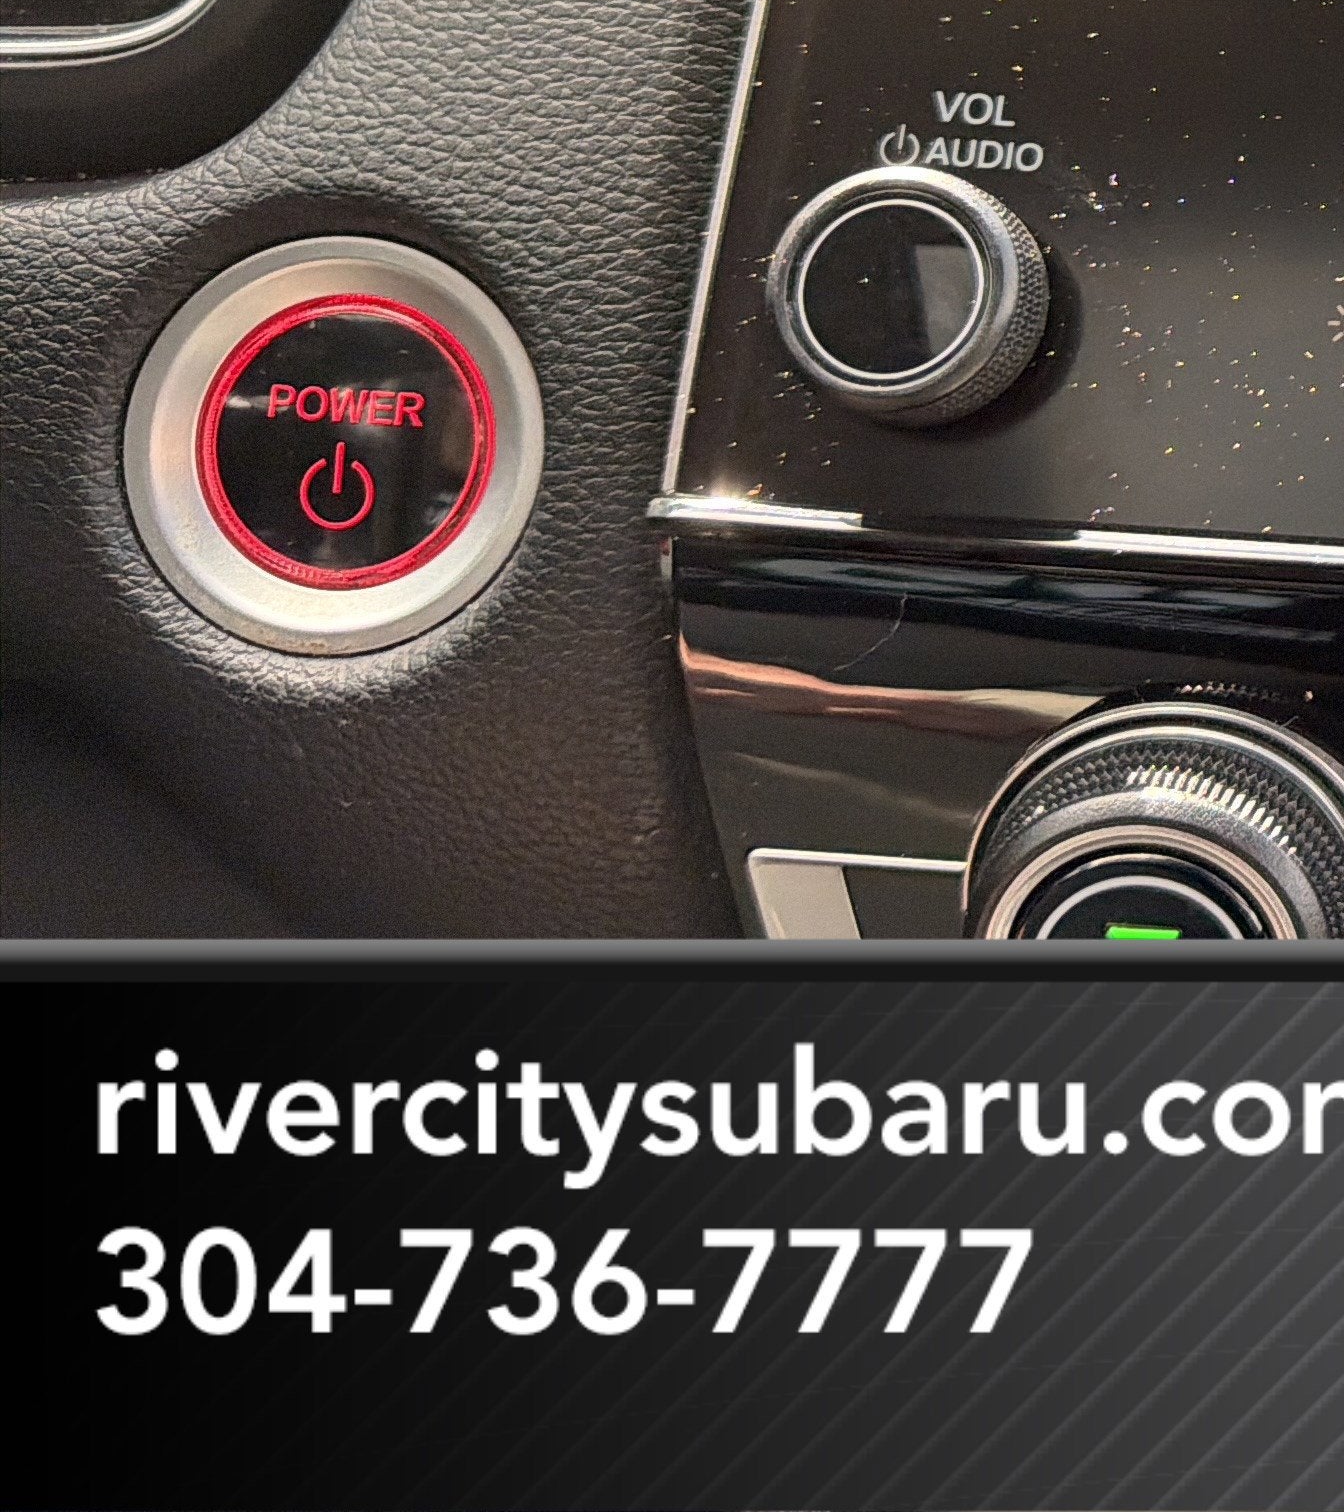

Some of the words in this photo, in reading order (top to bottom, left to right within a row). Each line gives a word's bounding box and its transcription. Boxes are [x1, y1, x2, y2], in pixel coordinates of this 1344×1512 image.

[932, 90, 1016, 128] VOL
[925, 137, 1044, 172] AUDIO
[266, 384, 426, 428] POWER
